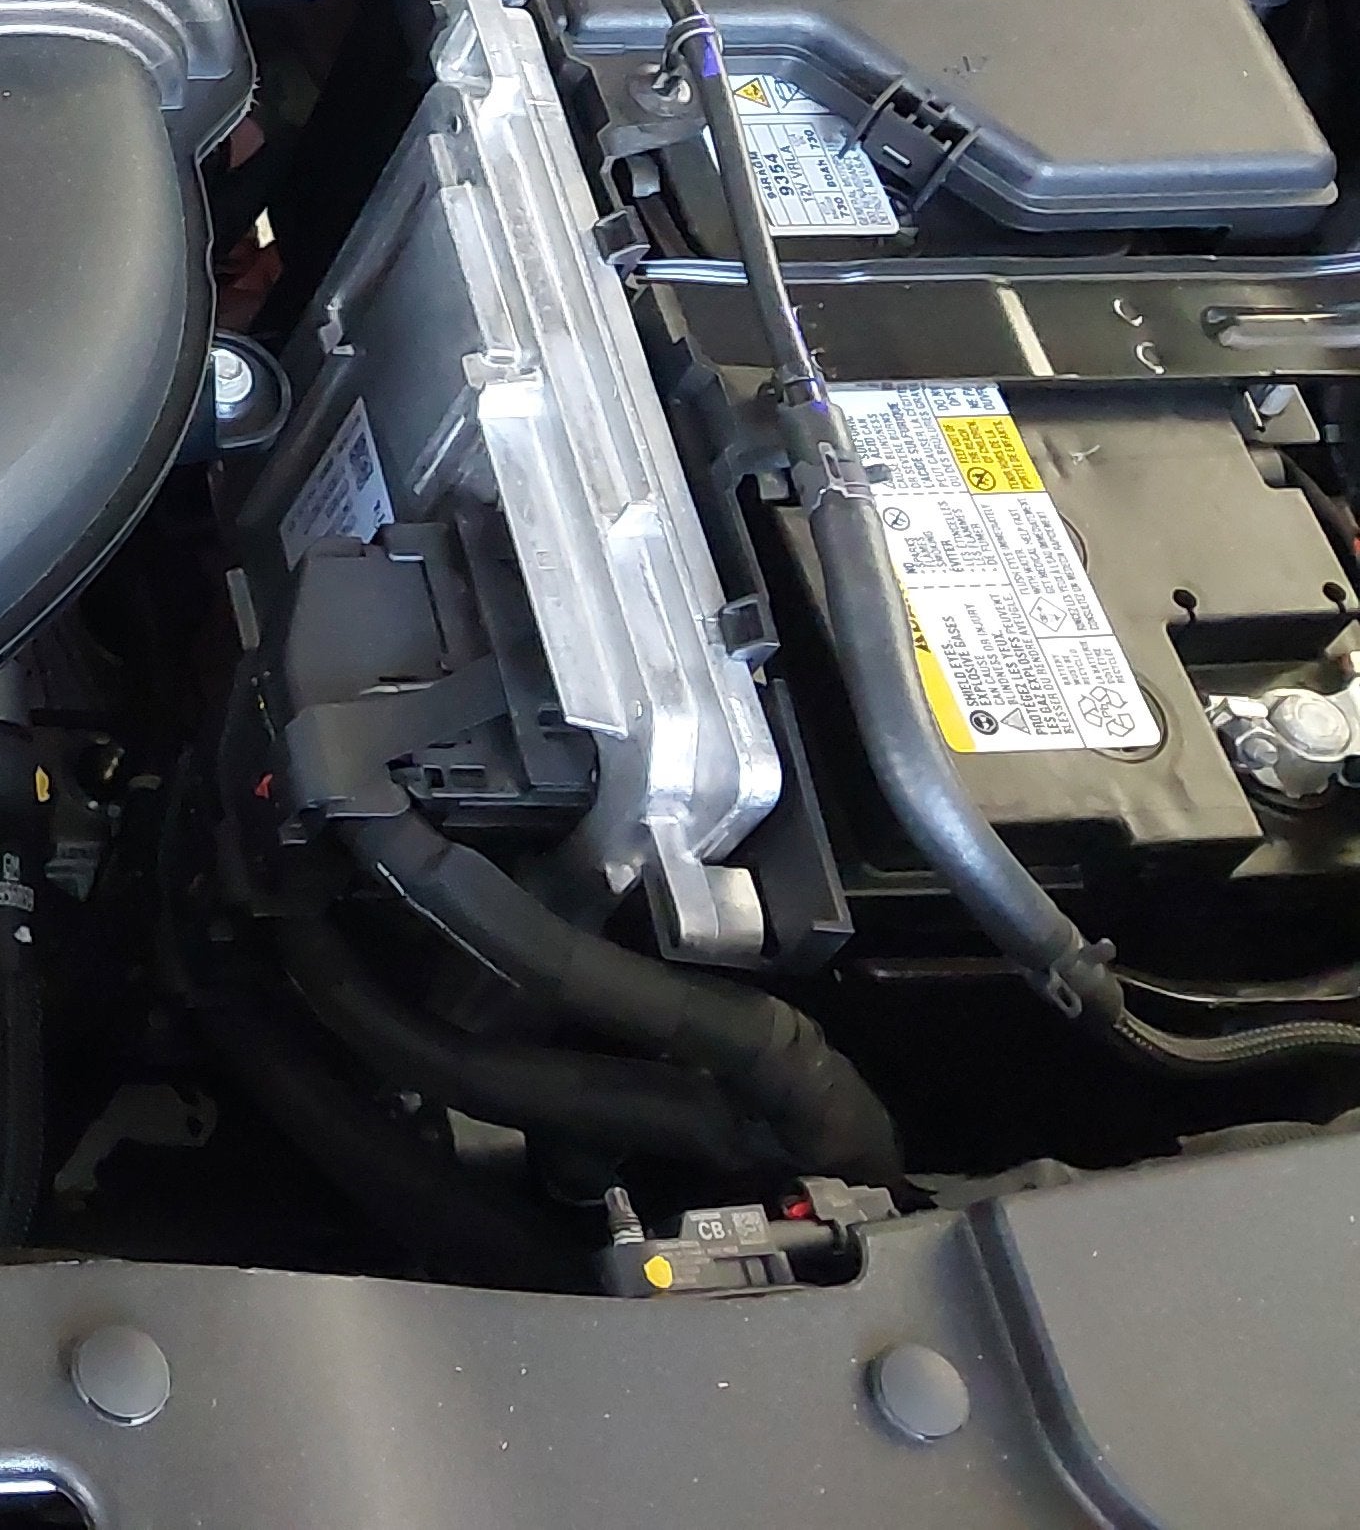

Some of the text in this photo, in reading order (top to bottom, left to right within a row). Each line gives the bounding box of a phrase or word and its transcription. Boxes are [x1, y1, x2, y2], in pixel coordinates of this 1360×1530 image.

[803, 129, 821, 151] 730
[769, 153, 795, 197] 9354
[834, 196, 851, 220] 730
[942, 616, 991, 705] EXPLOSIVE GASES
[1006, 662, 1023, 680] LES
[1009, 637, 1041, 690] EXPLOSIFS
[954, 672, 978, 706] SHIELD
[974, 656, 1005, 705] CAN CAUSE
[1044, 717, 1062, 734] LES
[697, 1220, 726, 1242] CB
